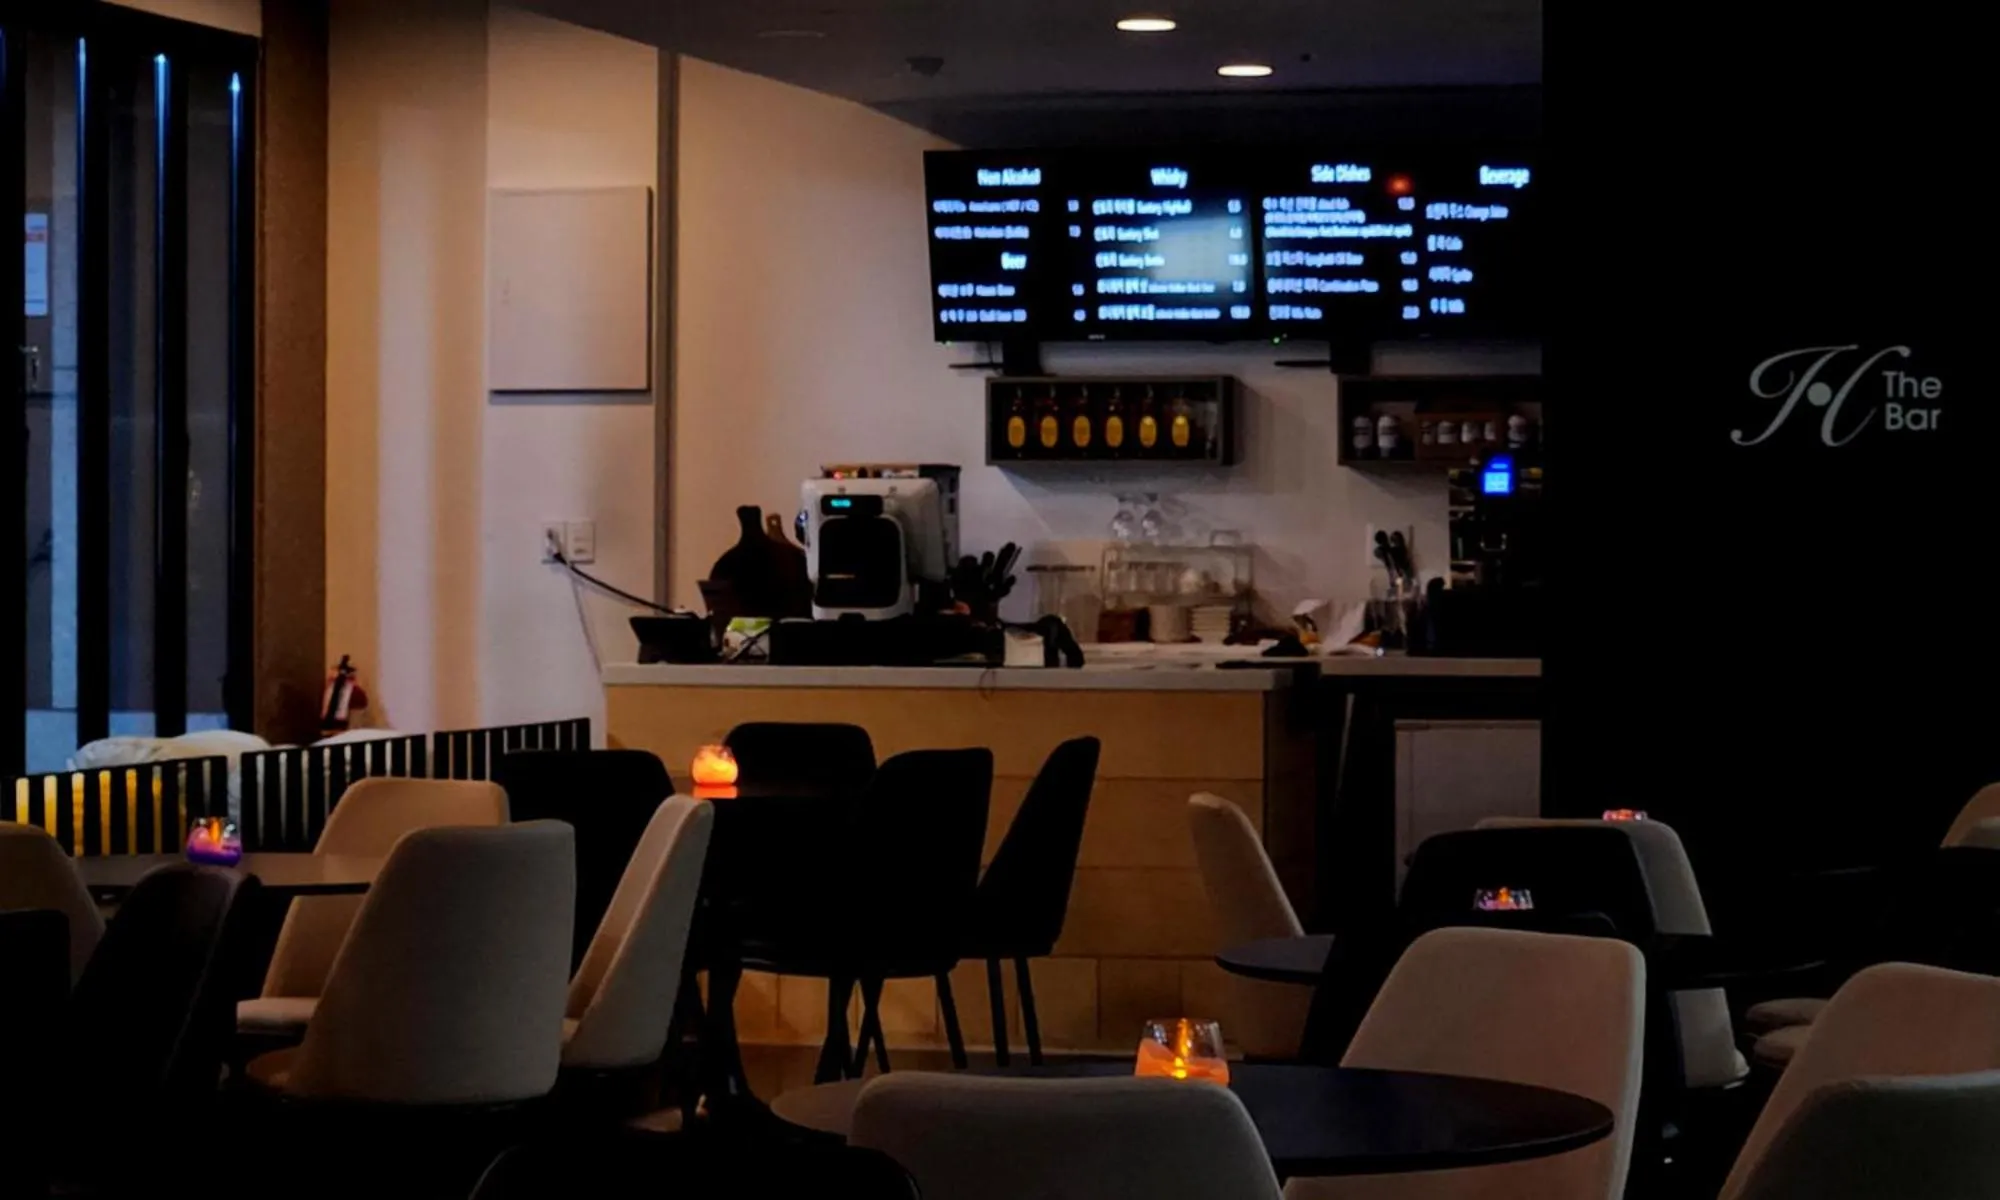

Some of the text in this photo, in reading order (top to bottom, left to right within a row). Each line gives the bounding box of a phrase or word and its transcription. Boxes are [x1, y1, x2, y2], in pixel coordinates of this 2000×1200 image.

[1311, 164, 1371, 182] Side Dishes
[1480, 165, 1530, 188] Beverage
[1881, 370, 1943, 399] The
[1884, 402, 1942, 431] Bar
